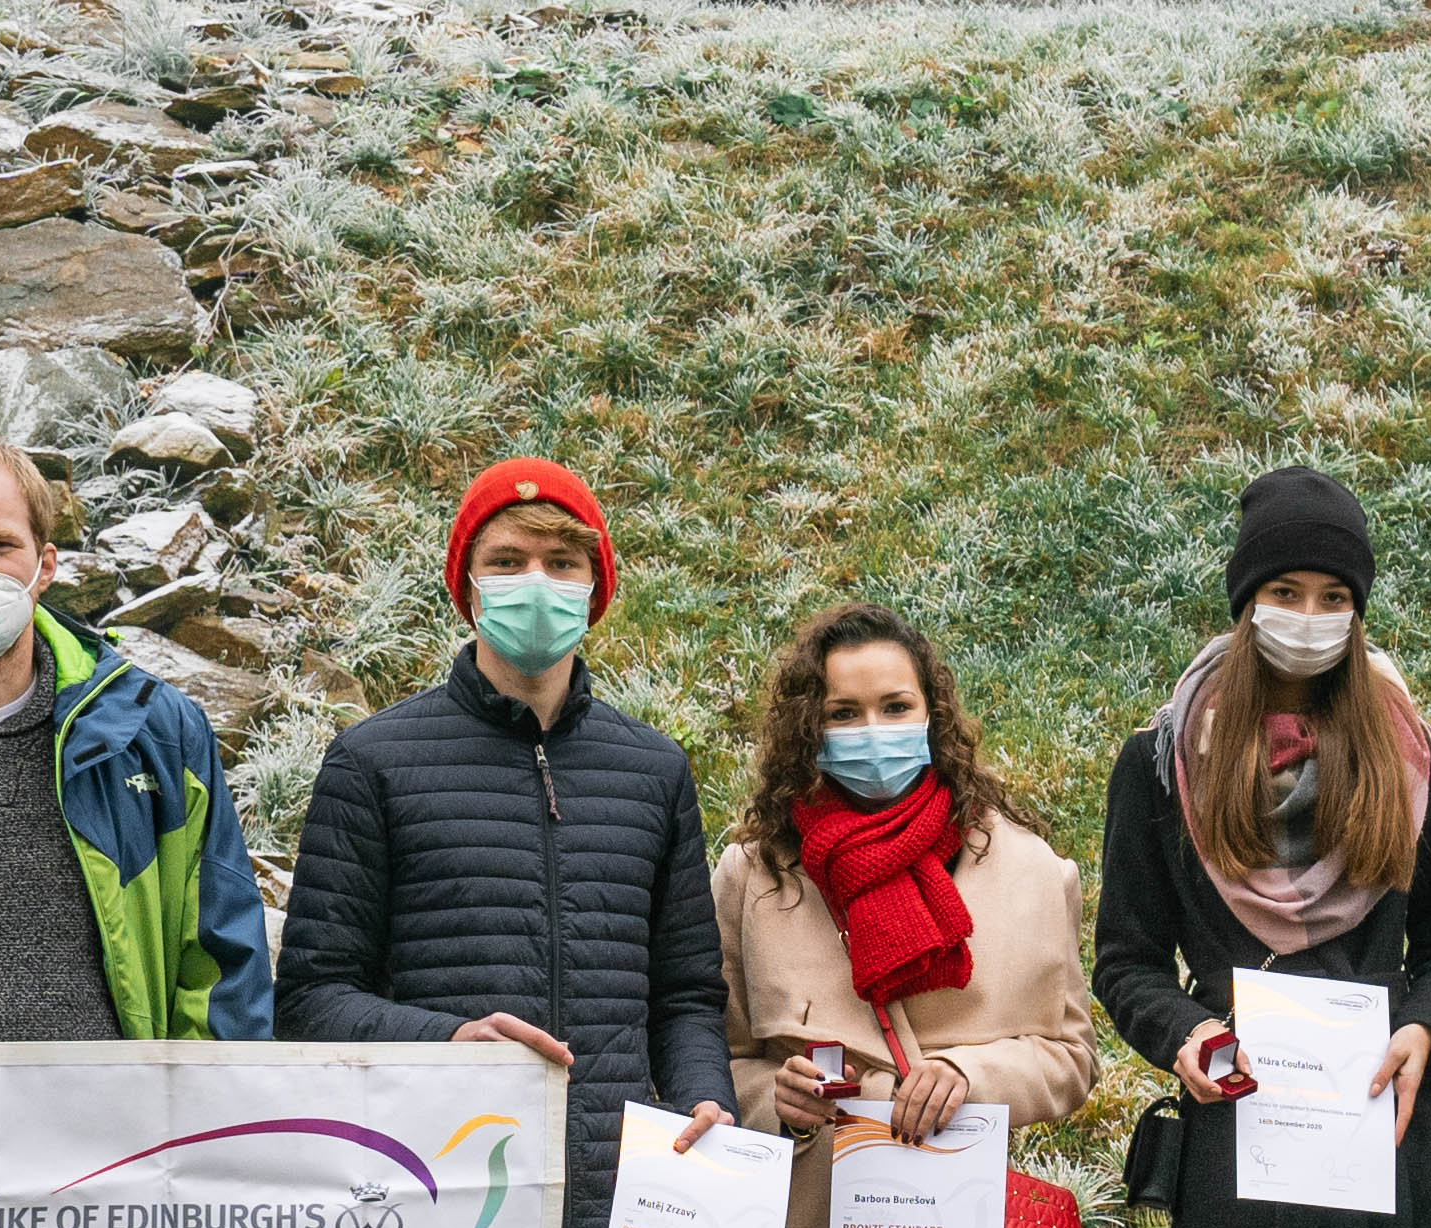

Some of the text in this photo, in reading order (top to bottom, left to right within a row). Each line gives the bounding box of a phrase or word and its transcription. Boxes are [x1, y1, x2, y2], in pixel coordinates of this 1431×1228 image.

[854, 1194, 935, 1205] Barbora Burešová
[637, 1198, 697, 1220] Matěj Zrzavý
